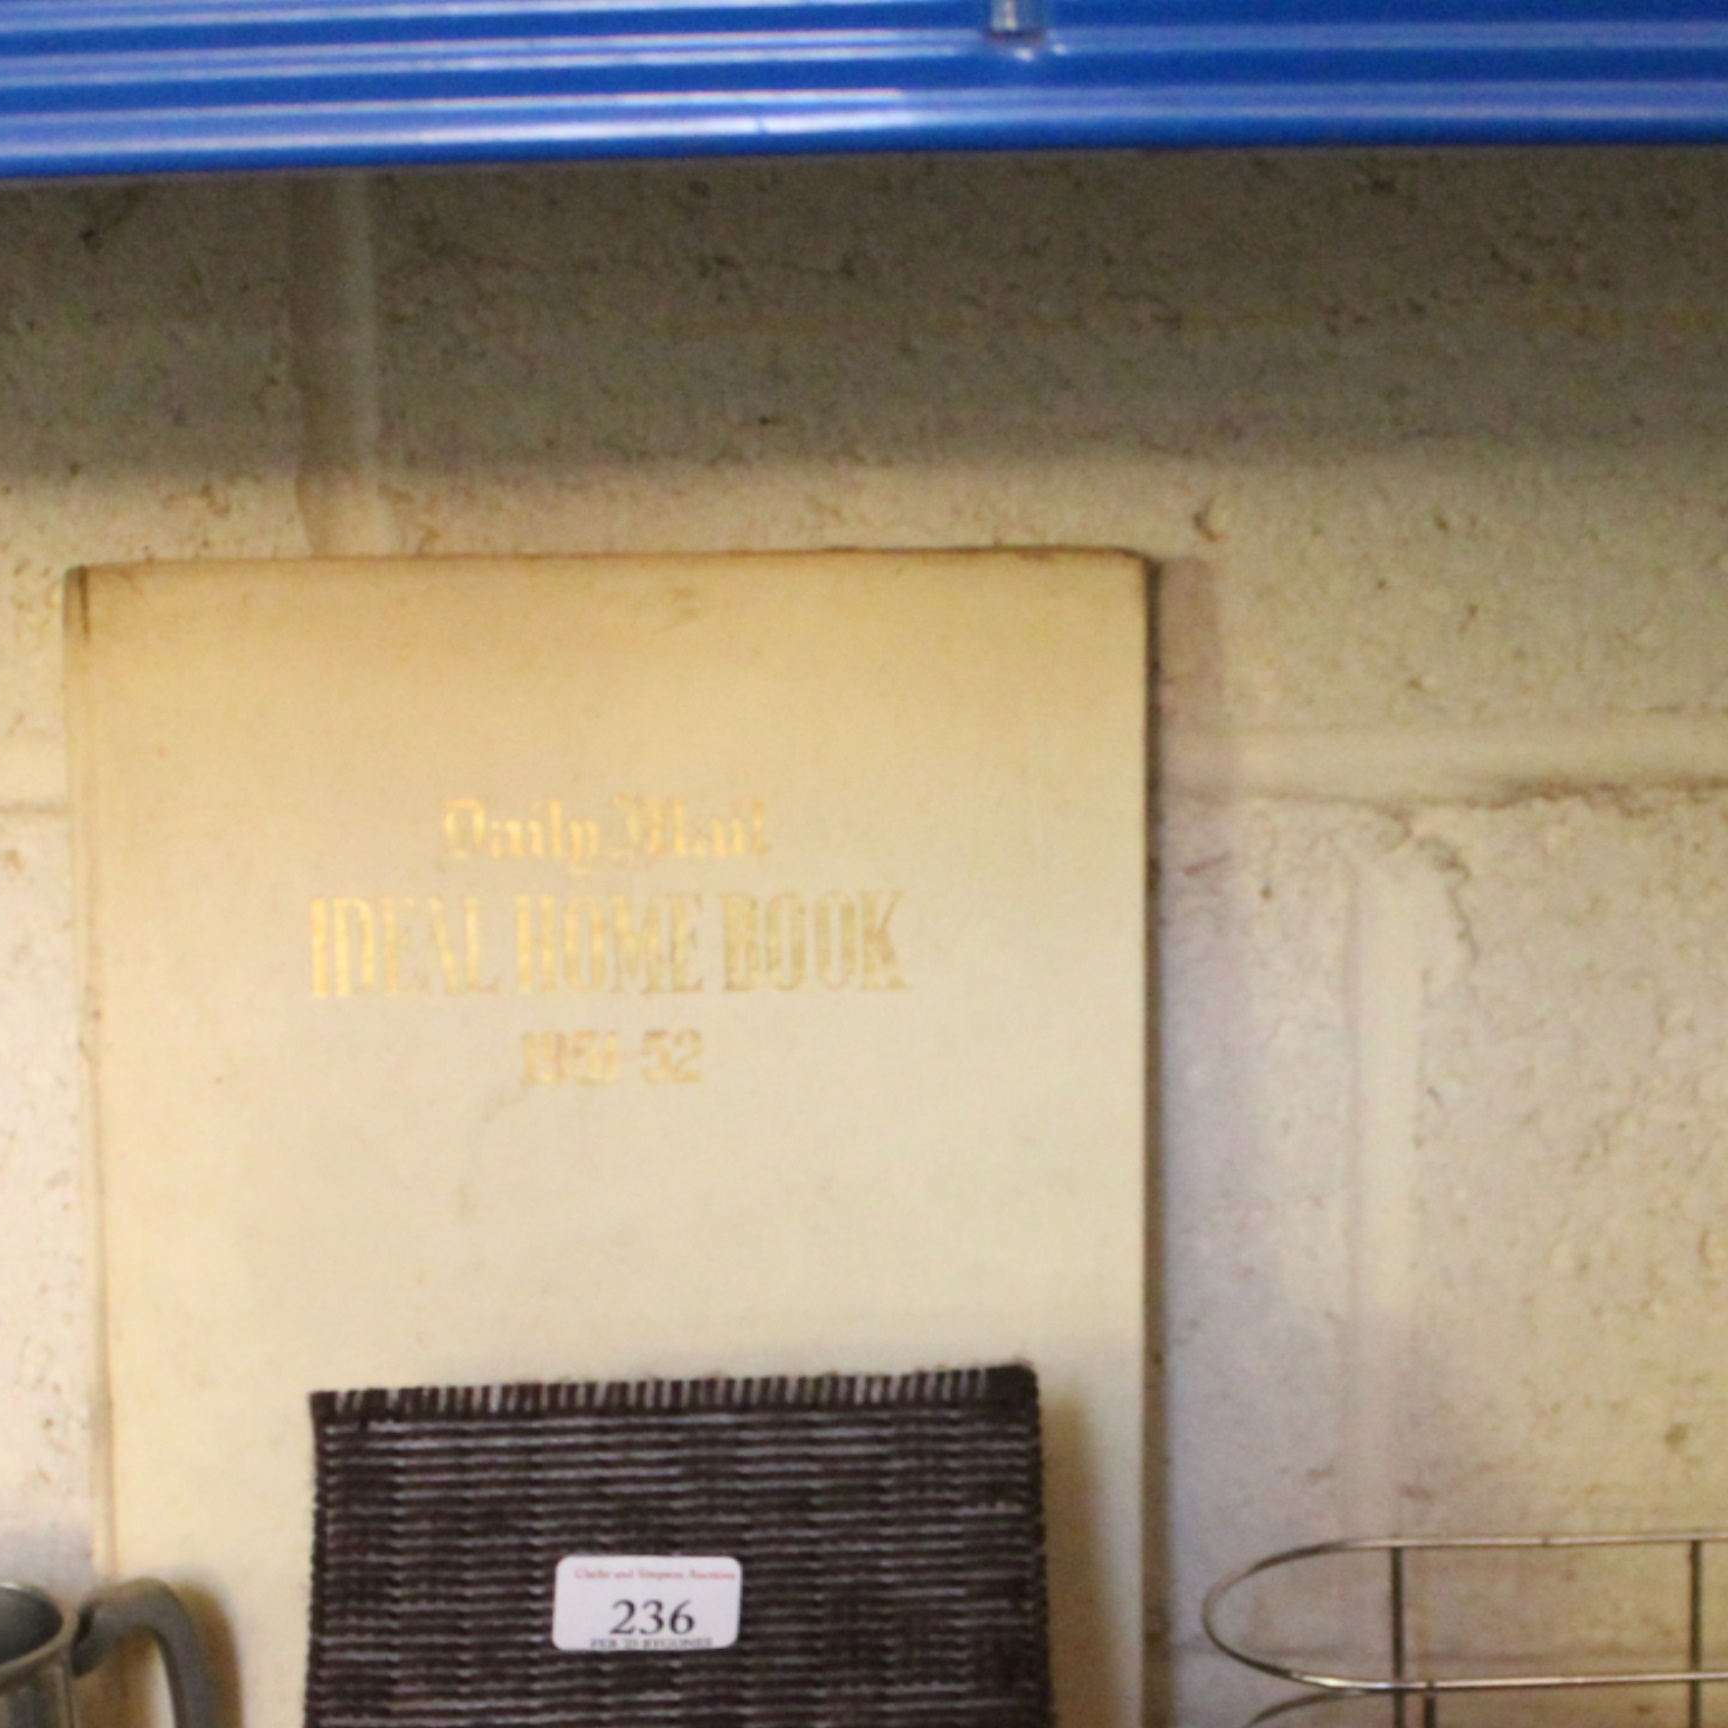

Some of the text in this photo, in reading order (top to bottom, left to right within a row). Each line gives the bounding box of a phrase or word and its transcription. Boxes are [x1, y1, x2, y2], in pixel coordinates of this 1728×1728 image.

[437, 793, 773, 874] Daily Mail
[309, 888, 913, 998] IDEAL HOME BOOK
[607, 1598, 697, 1636] 236
